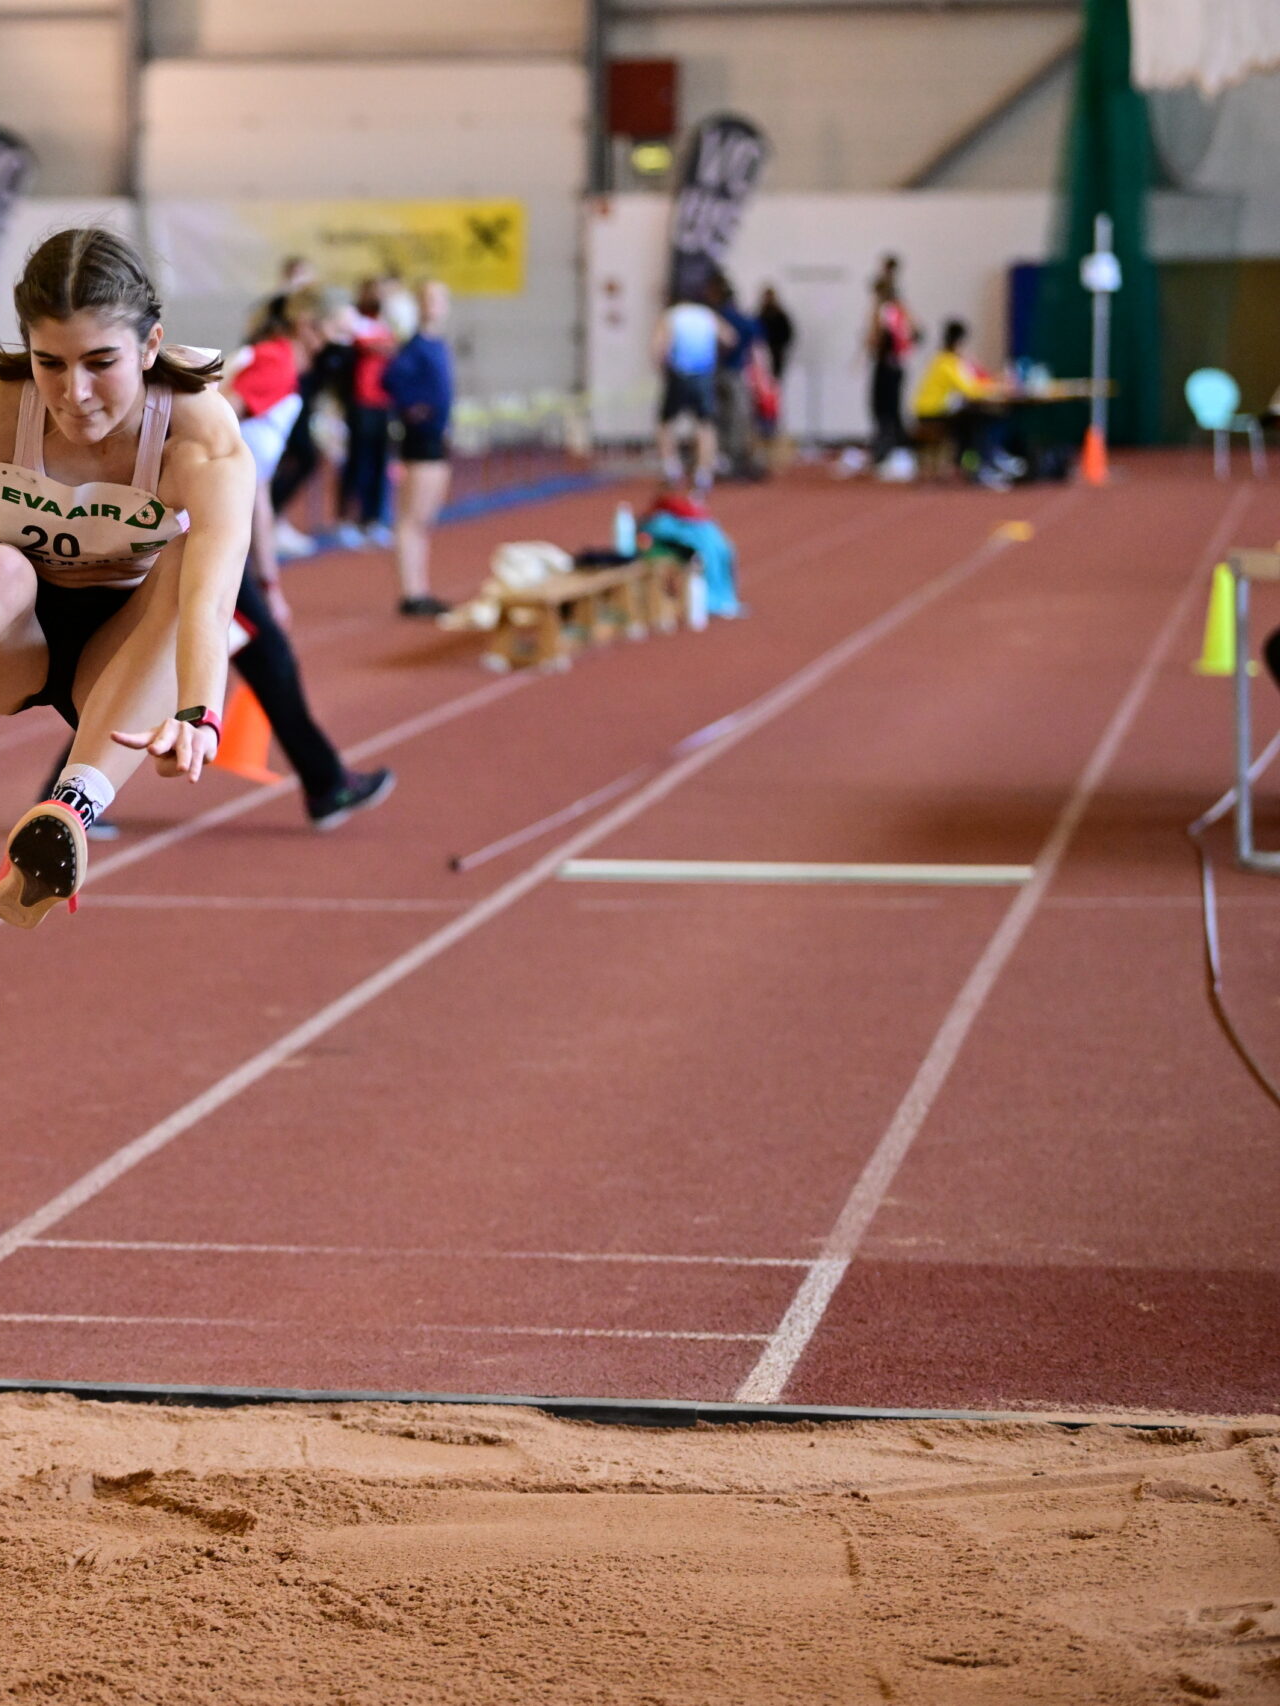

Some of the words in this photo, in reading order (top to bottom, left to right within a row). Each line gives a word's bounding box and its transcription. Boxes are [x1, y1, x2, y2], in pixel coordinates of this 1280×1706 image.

[1, 486, 63, 517] EVA
[66, 503, 122, 521] AIR
[21, 525, 81, 558] 20
